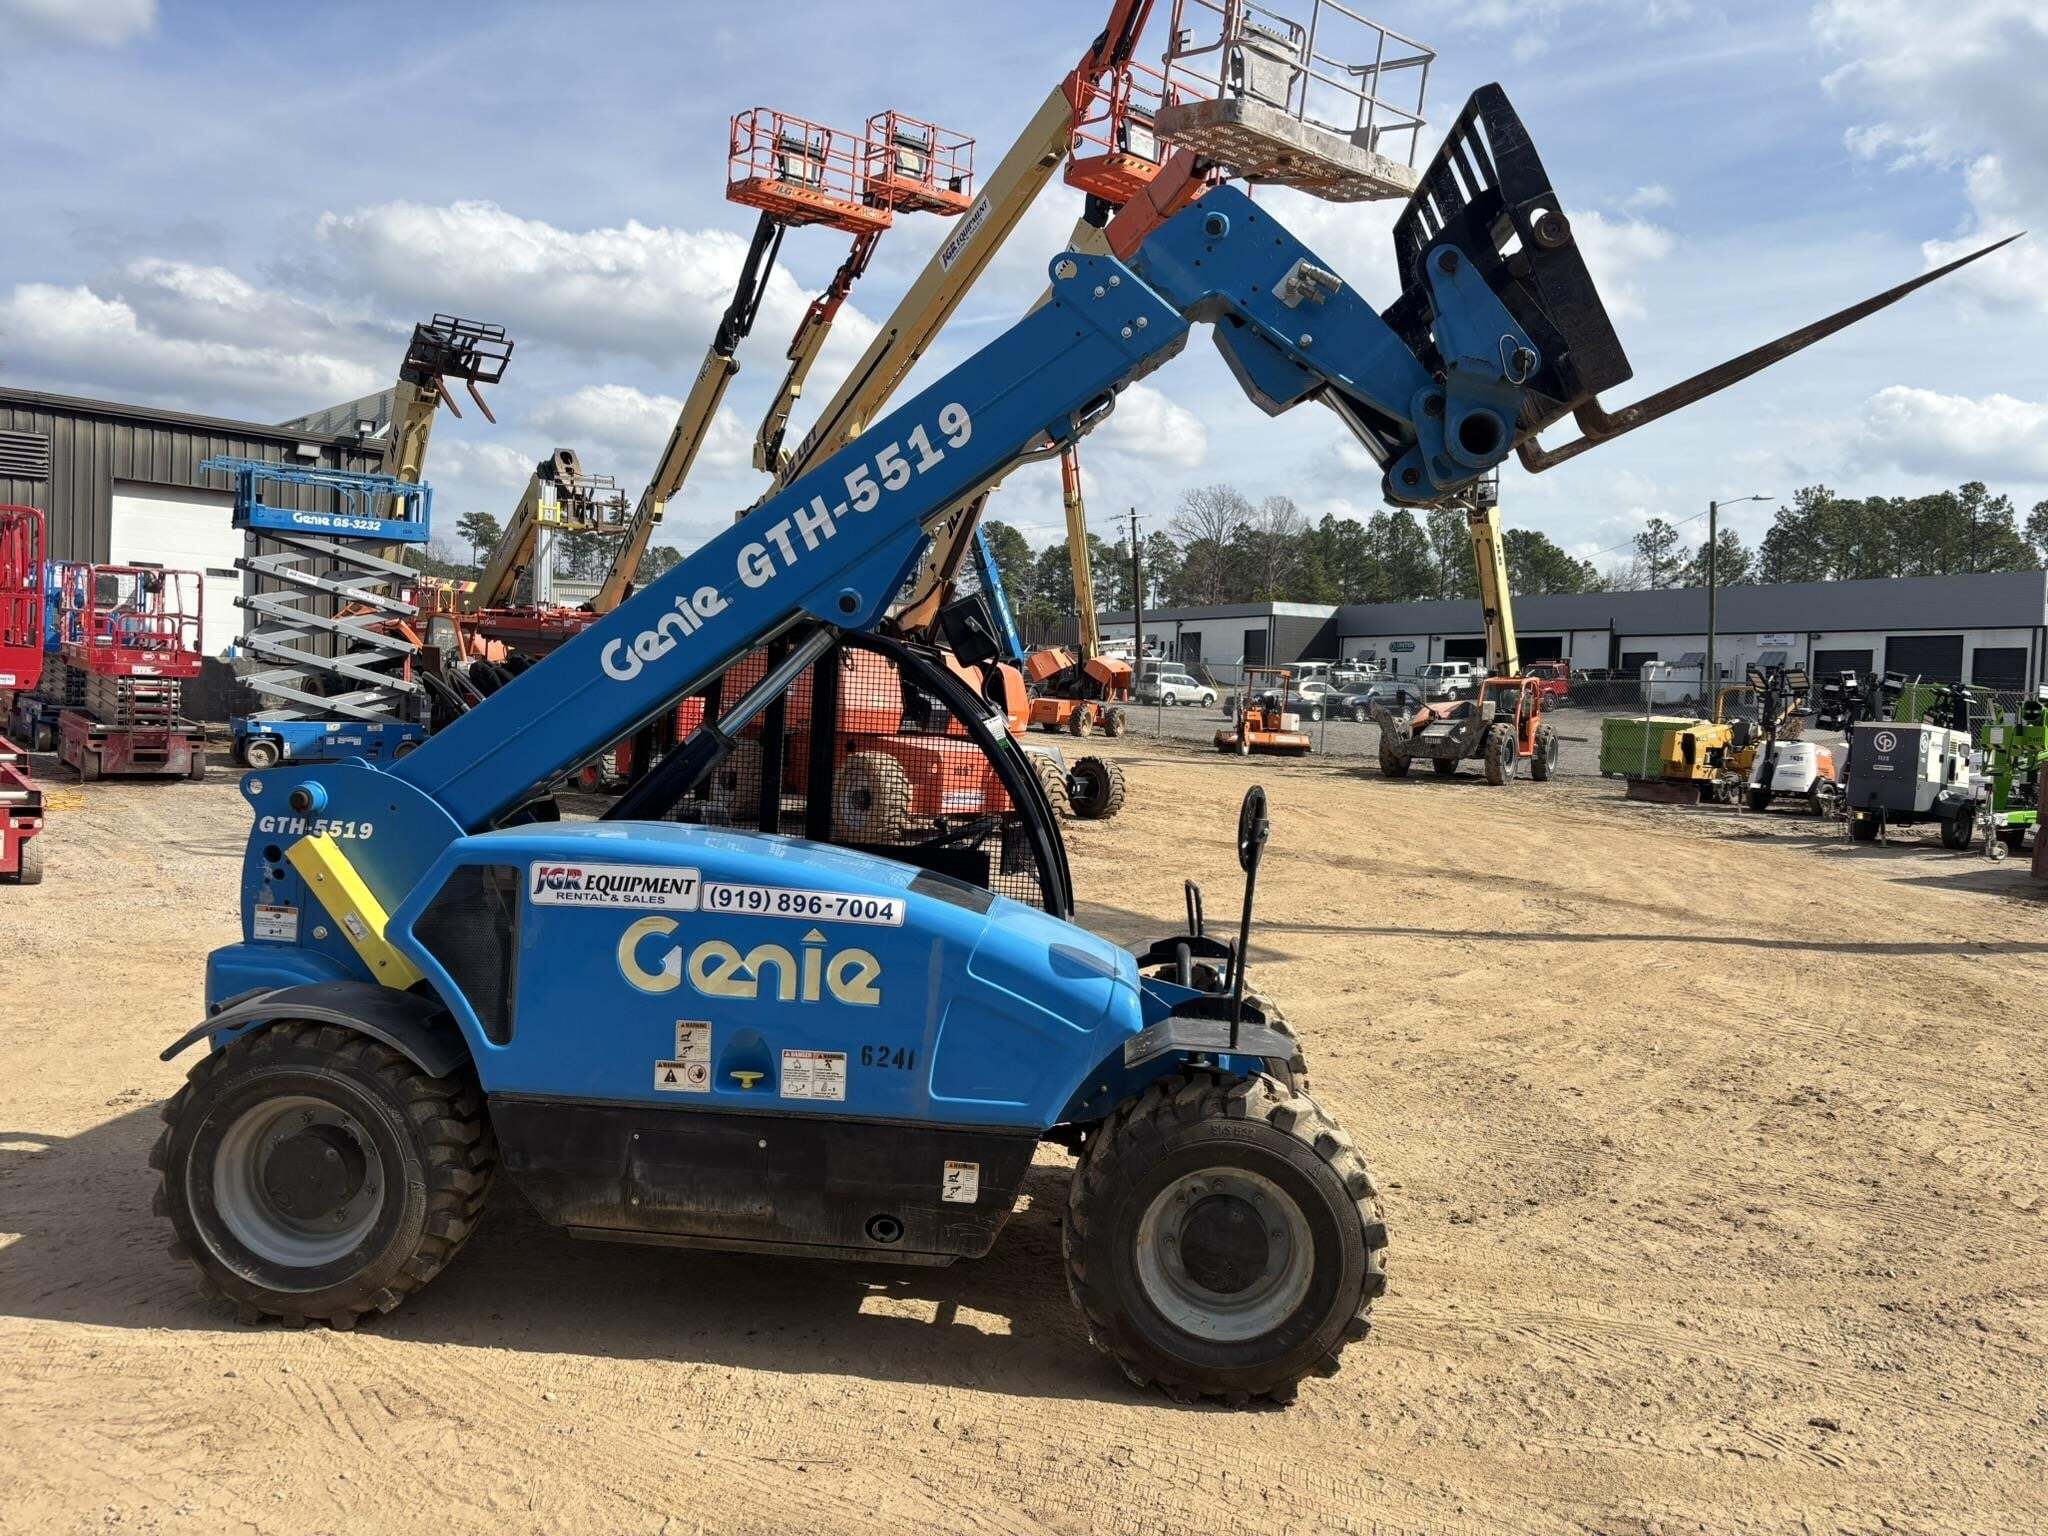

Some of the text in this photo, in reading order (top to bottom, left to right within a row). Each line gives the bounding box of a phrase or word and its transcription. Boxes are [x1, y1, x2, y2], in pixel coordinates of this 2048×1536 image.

[942, 200, 988, 268] JGR EQUIPMENT
[293, 512, 381, 532] Genie GS-3232
[600, 402, 972, 681] Genie GTH-5519
[259, 815, 374, 840] GTH-5519
[533, 866, 696, 896] JGR EQUIPMENT
[556, 891, 665, 904] RENTAL & SALES
[710, 886, 893, 921] (919) 896-7004
[618, 915, 881, 1006] Genie
[861, 1044, 915, 1071] 6241
